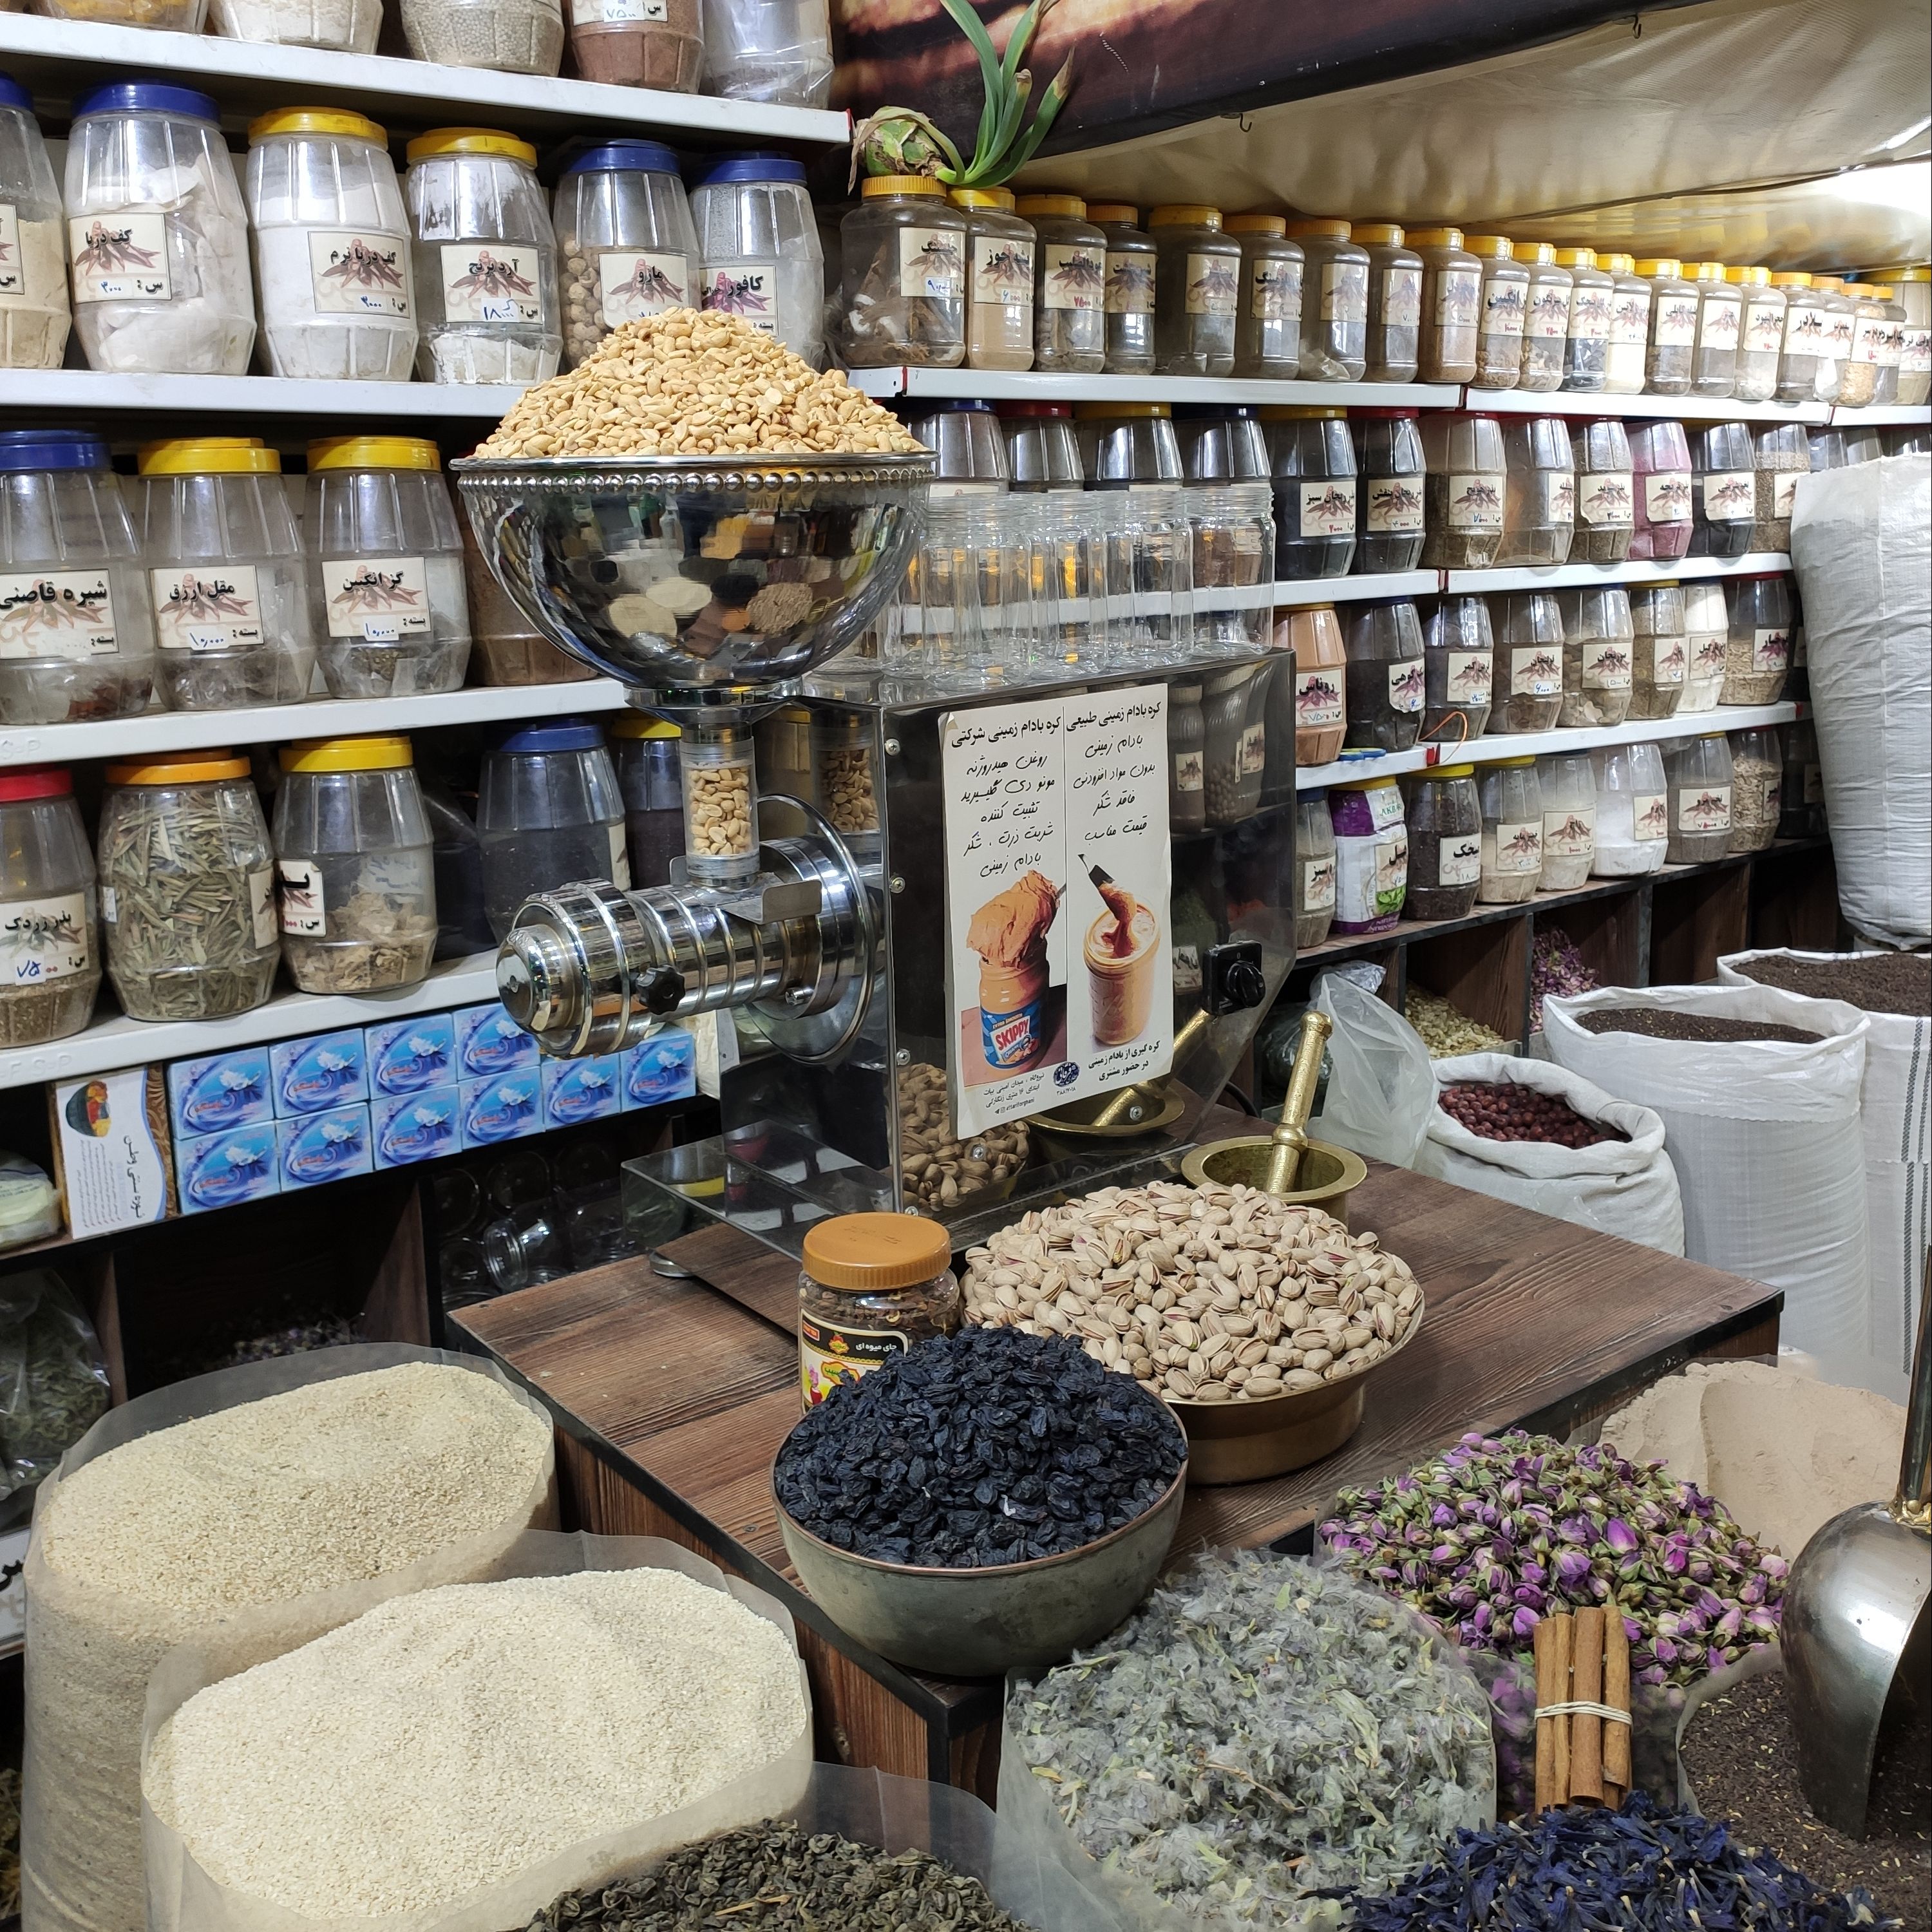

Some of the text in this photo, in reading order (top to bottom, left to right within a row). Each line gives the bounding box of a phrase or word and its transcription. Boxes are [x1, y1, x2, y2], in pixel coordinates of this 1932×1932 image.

[84, 231, 107, 250] دریا
[468, 260, 495, 276] برنج
[638, 266, 663, 285] مازو
[727, 274, 764, 298] کافور
[207, 580, 236, 599] مقل
[343, 570, 404, 592] گز انگبین
[63, 580, 108, 607] شیره
[1299, 677, 1334, 696] روناس
[1066, 701, 1162, 732] کره بادام زمینی طبیعی
[951, 715, 1061, 748] کره بادام زمینی شرکتی
[1084, 734, 1144, 759] بادام زمینی
[966, 750, 1048, 779] روغن هیدروژنه
[1072, 763, 1156, 789] بدون مواد افزودنی
[960, 775, 1056, 805] مونو دی گلیسیرید
[980, 800, 1041, 822] تثبیت کننده
[1092, 789, 1136, 817] فاقد شکر
[963, 821, 1054, 857] شربت ذرت شکر
[1084, 814, 1149, 846] قیمت مناسب
[980, 851, 1042, 878] بادام زمینی
[995, 1018, 1029, 1051] SKIPPY
[1148, 1040, 1160, 1053] کره
[1088, 1056, 1108, 1069] زمینی
[1108, 1050, 1124, 1064] بادام
[1124, 1047, 1131, 1060] از
[1099, 1060, 1149, 1081] در حضور مشتری
